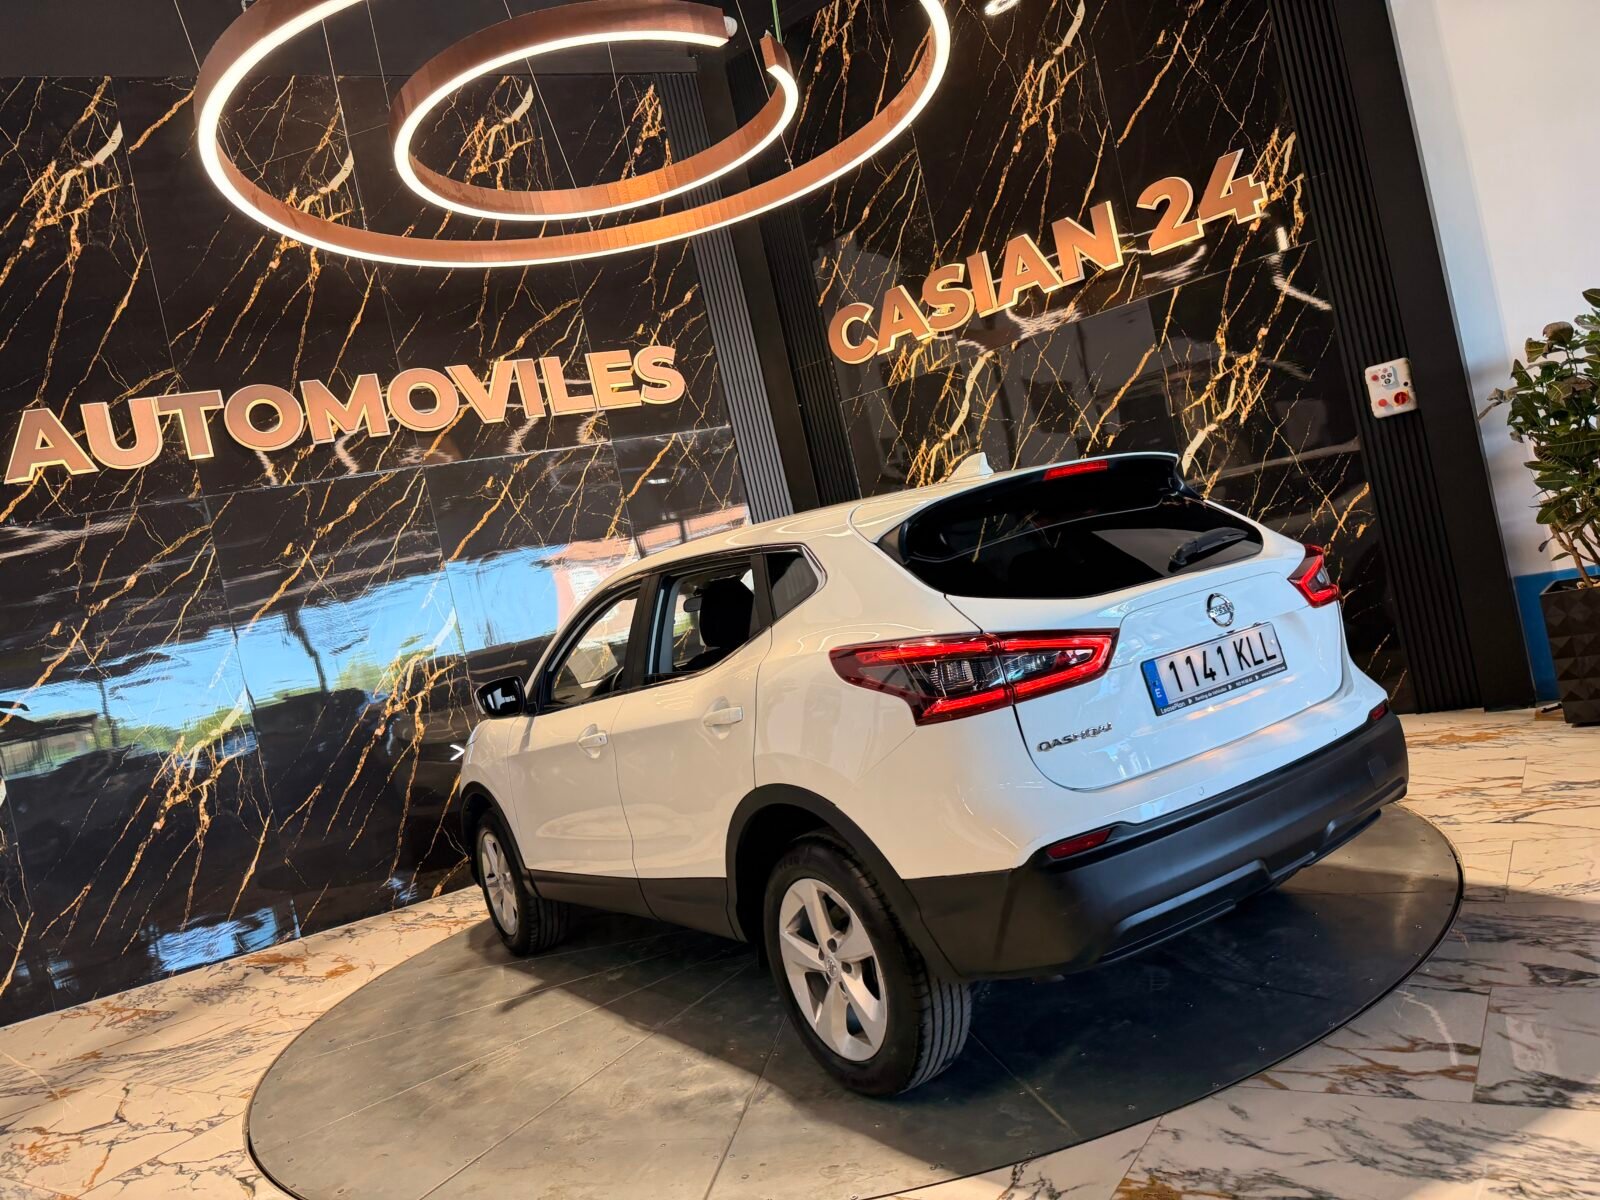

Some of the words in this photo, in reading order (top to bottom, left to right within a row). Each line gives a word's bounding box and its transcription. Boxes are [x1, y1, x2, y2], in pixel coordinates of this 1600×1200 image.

[827, 200, 1124, 365] CASIAN
[1136, 148, 1268, 256] 24
[4, 345, 686, 485] AUTOMOVILES
[1154, 688, 1162, 698] E
[1168, 645, 1230, 692] 1141
[1233, 631, 1277, 671] KLL
